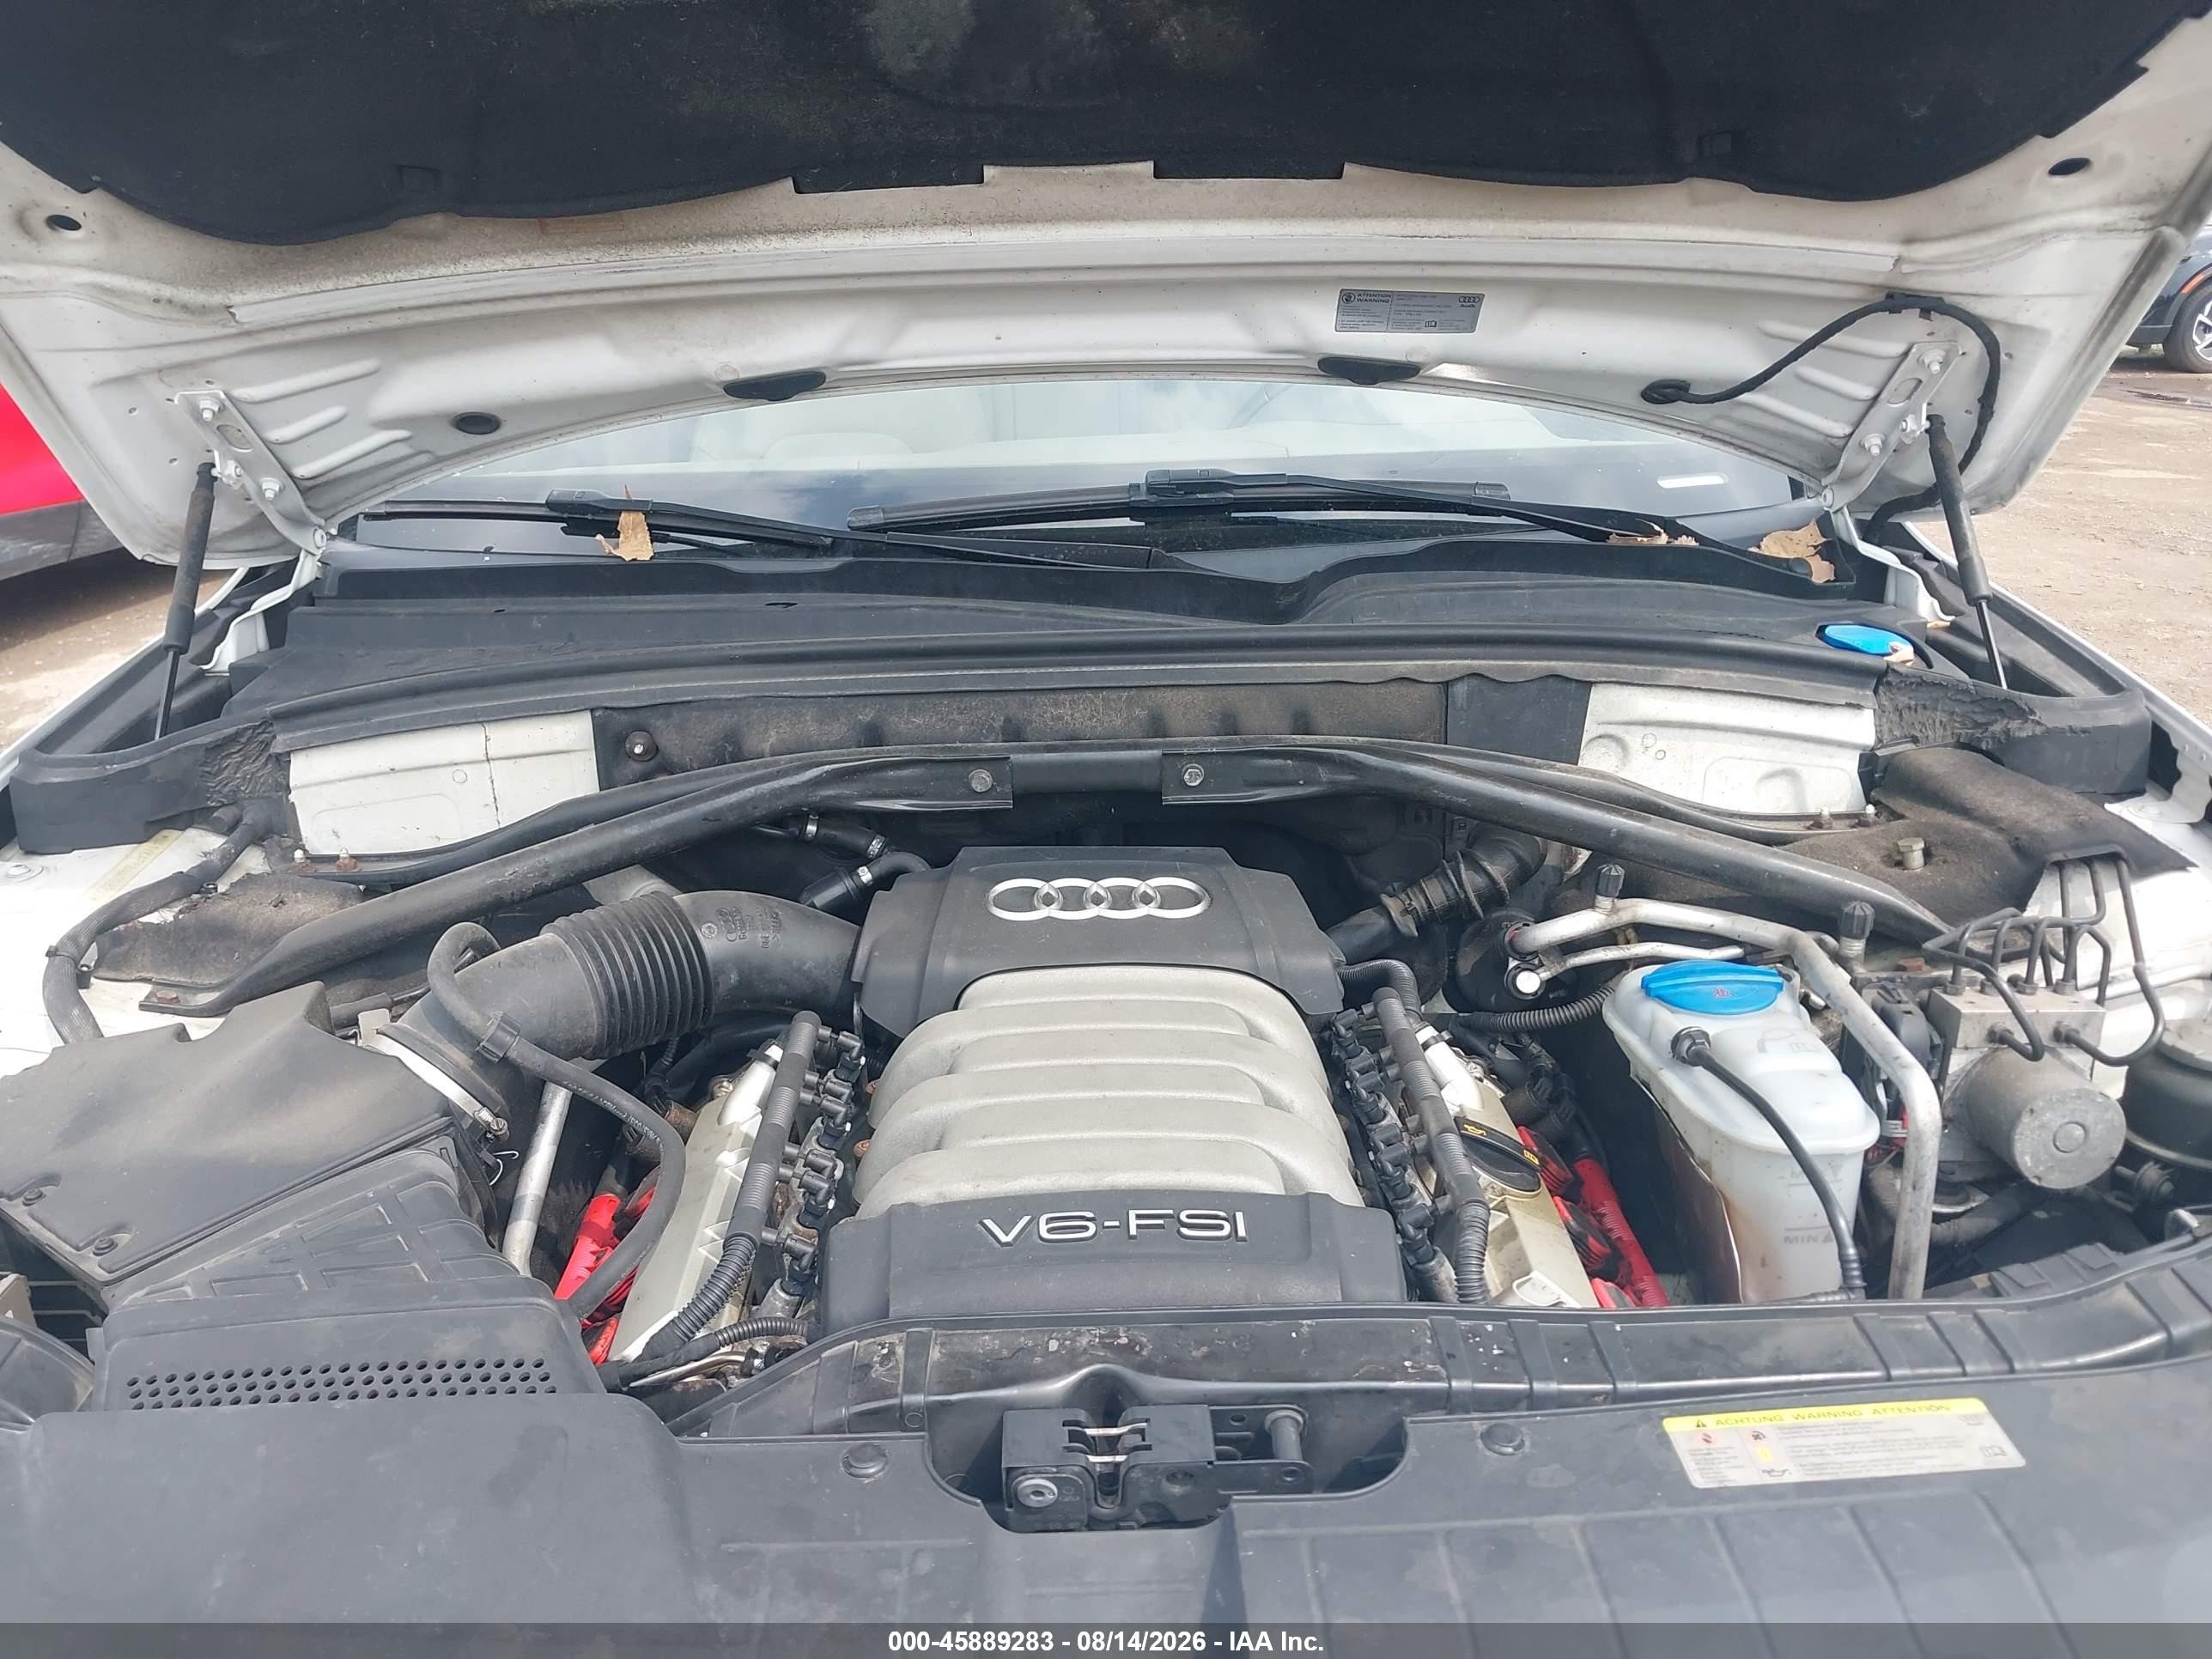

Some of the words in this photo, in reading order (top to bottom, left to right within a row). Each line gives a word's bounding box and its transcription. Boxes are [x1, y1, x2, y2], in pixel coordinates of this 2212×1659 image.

[979, 1208, 1250, 1248] V6-FSI
[1784, 1235, 1818, 1244] MIN
[1714, 1414, 1784, 1426] ACHTUNG
[1792, 1408, 1863, 1421] WARNING
[1872, 1404, 1951, 1416] ATTENTION
